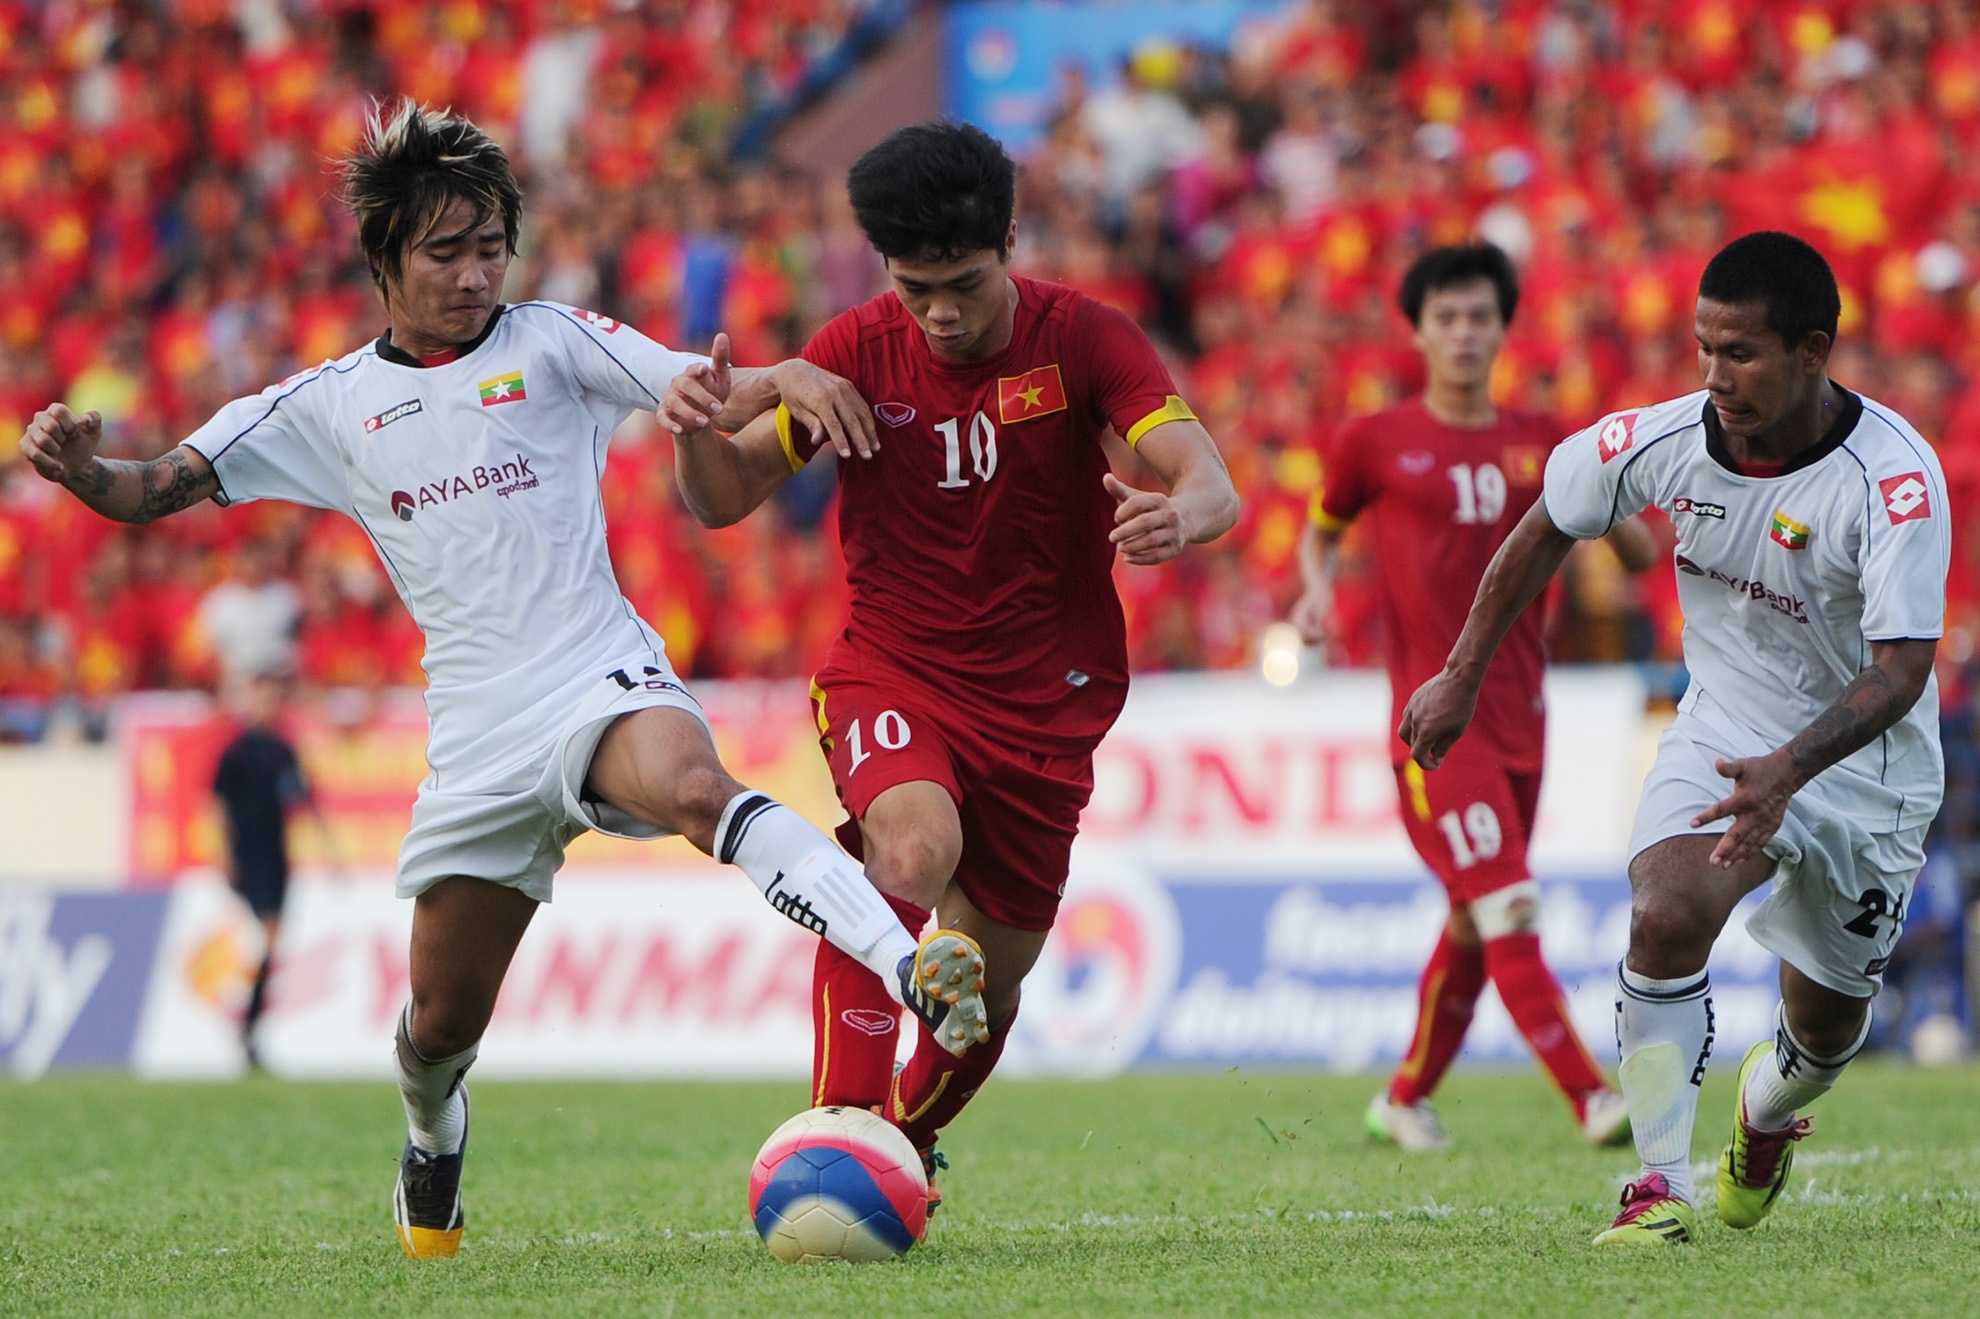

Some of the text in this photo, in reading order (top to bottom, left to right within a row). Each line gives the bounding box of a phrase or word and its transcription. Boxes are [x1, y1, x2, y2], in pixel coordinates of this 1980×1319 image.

[380, 401, 421, 426] lotto
[419, 453, 535, 510] AYA Bank
[933, 410, 998, 489] 10
[1446, 462, 1508, 525] 19
[1690, 502, 1725, 517] lotto
[844, 709, 912, 777] 10
[1437, 801, 1503, 871] 19
[764, 869, 828, 937] lotto
